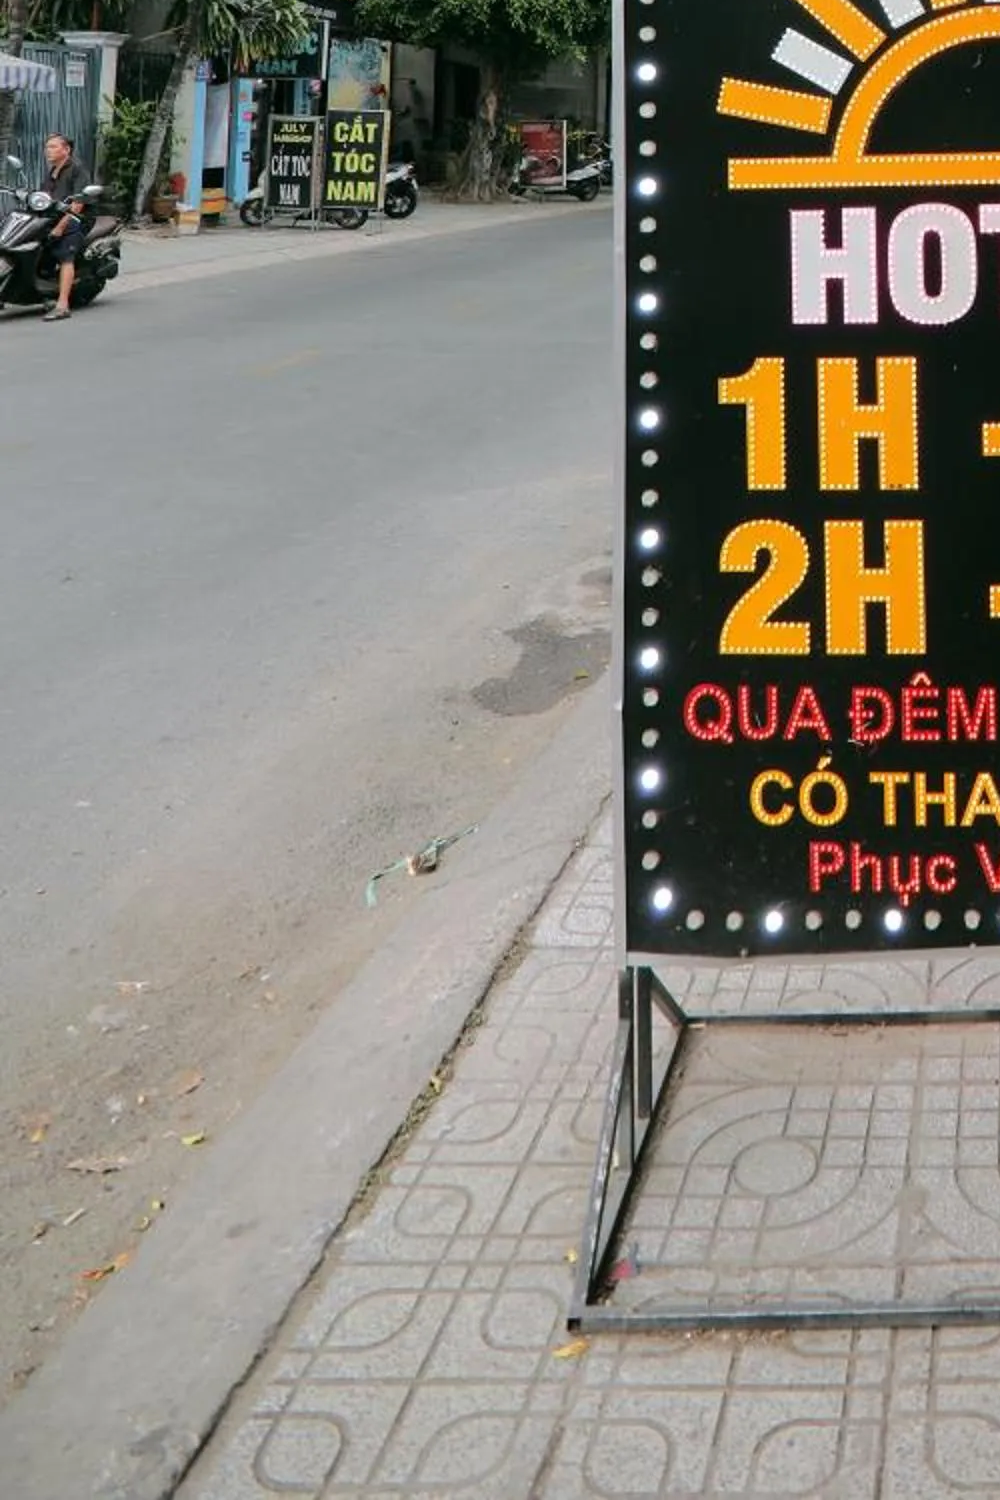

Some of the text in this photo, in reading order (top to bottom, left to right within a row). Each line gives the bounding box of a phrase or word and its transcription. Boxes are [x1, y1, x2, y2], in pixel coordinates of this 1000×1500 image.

[332, 148, 376, 173] TÓC
[333, 115, 378, 143] CẮT
[327, 180, 377, 202] NAM
[717, 356, 920, 491] 1H
[718, 518, 927, 655] 2H
[682, 681, 831, 744] QUA
[848, 671, 998, 742] ĐÊM
[749, 755, 849, 828] CÓ
[808, 840, 957, 906] Phục
